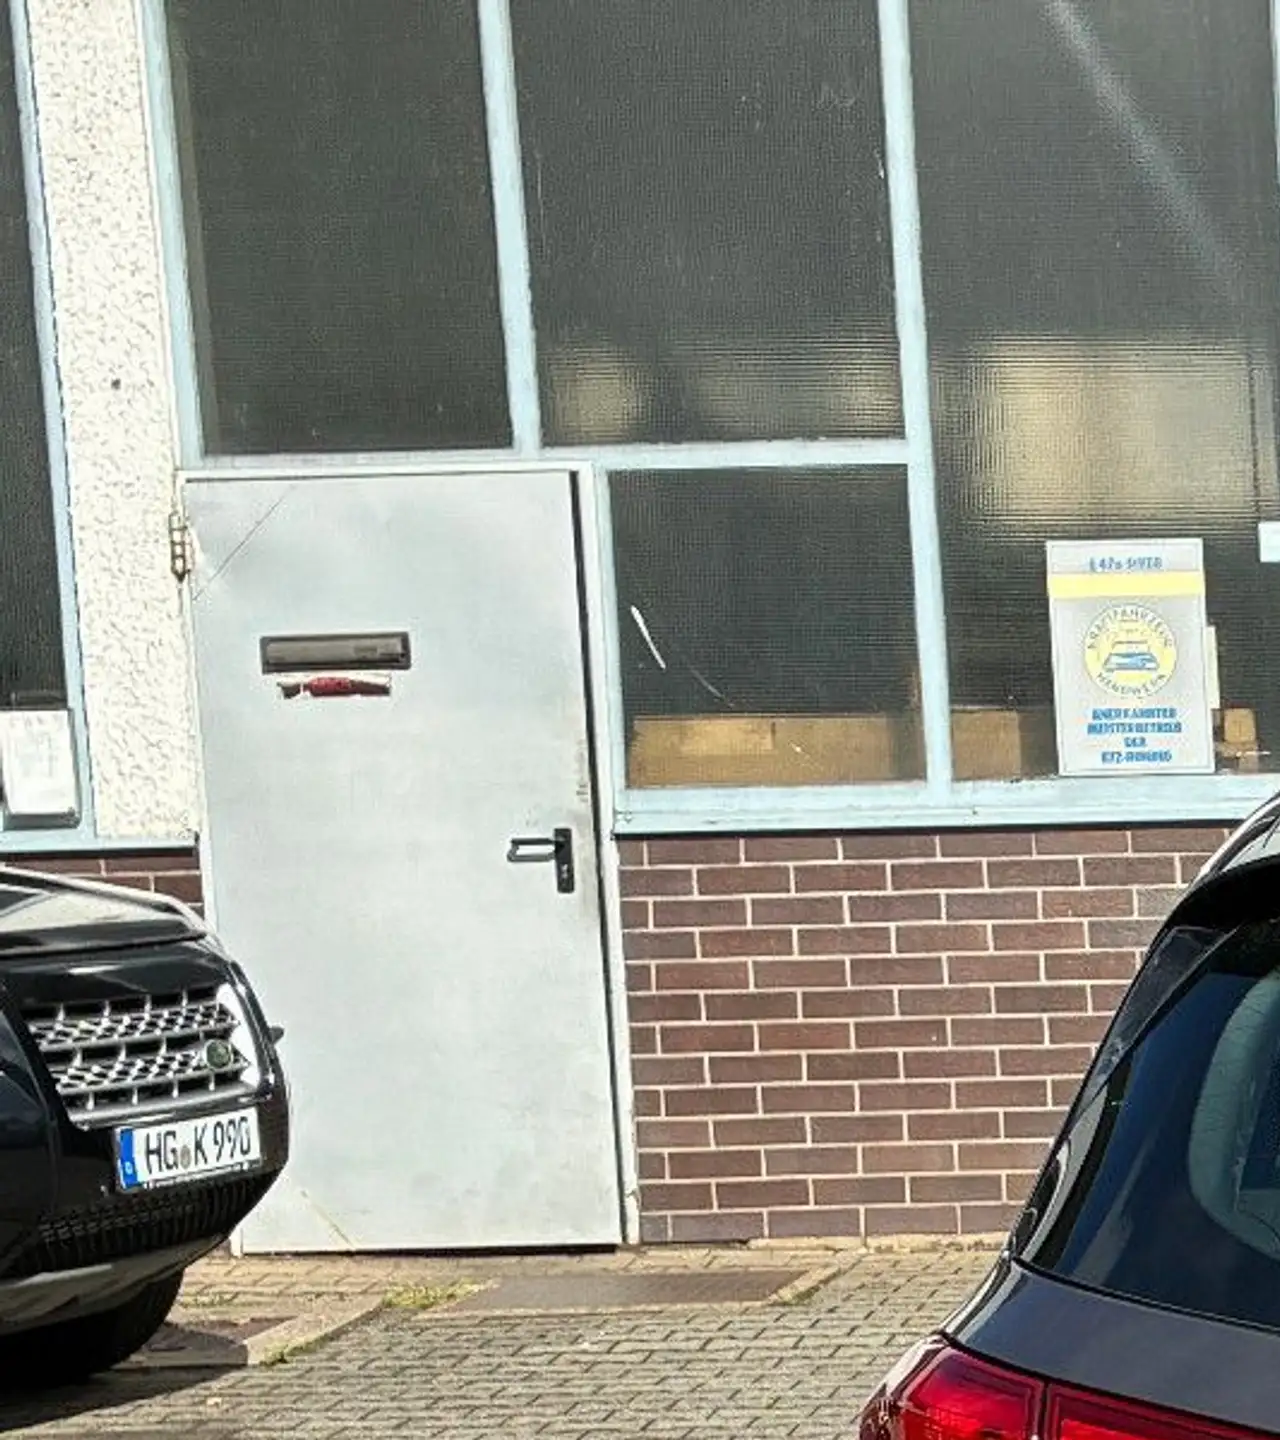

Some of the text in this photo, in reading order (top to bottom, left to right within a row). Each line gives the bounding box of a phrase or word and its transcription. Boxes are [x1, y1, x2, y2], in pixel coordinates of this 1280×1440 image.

[145, 1115, 252, 1174] HG K 990
